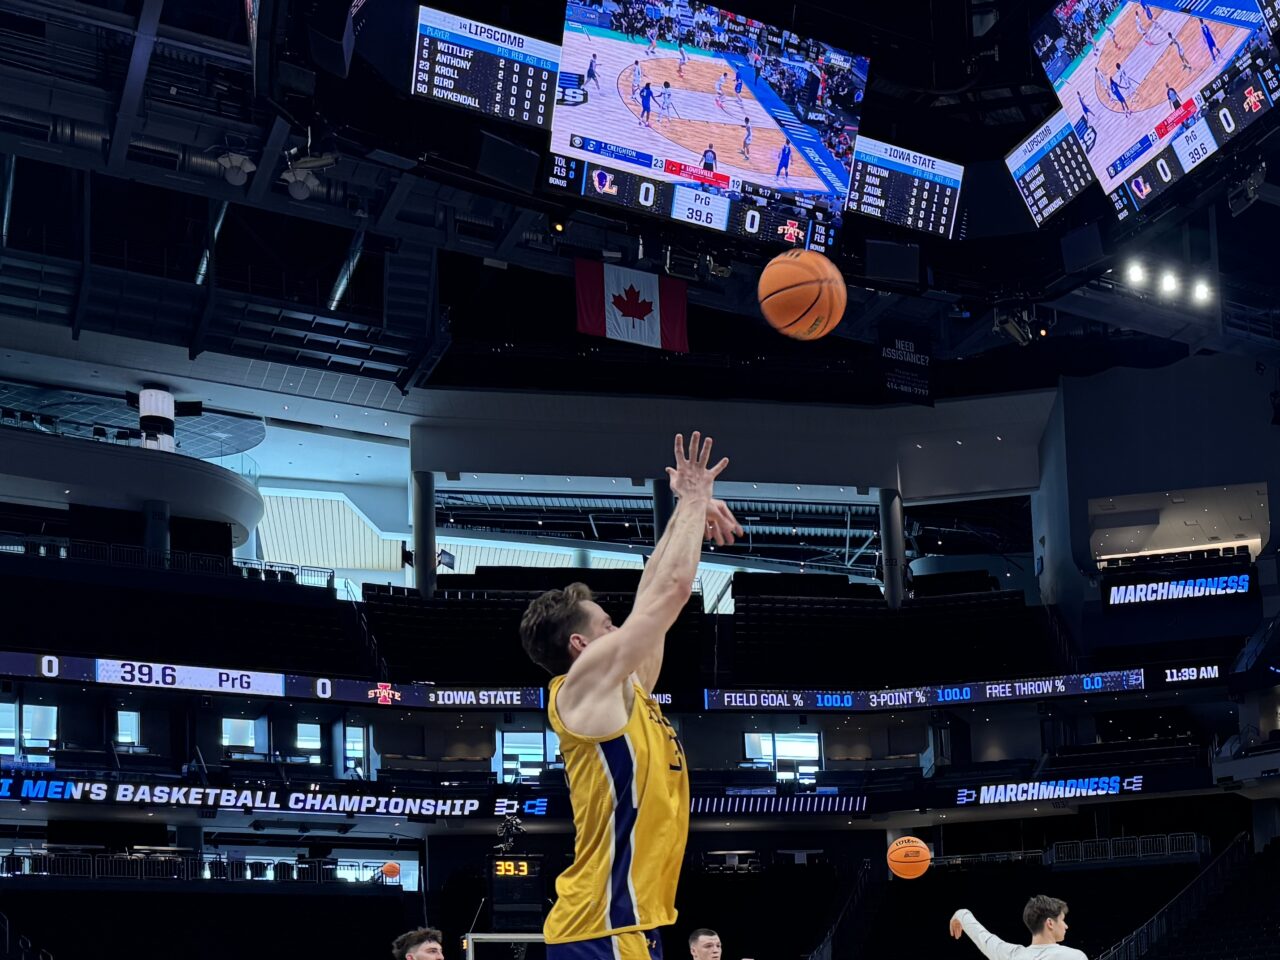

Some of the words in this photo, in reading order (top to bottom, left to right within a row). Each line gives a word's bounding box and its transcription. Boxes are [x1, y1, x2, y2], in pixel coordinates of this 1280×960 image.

[1210, 5, 1232, 19] FIRST
[1232, 8, 1261, 23] ROUND
[1264, 7, 1273, 19] 23
[1269, 18, 1278, 29] 45
[468, 23, 524, 48] LIPSCOMB
[426, 26, 450, 40] PLAYER
[497, 47, 509, 57] PTS
[511, 51, 524, 61] REB
[525, 55, 537, 65] AST
[540, 58, 551, 69] FLS
[436, 41, 473, 59] WITTLIFF
[419, 60, 430, 71] 23
[435, 64, 459, 79] KROLL
[436, 53, 471, 70] ANTHONY
[417, 72, 429, 82] 24
[434, 76, 454, 89] BIRD
[416, 83, 428, 94] 50
[432, 87, 480, 108] KUYKENDALL
[1219, 107, 1235, 134] 0
[1025, 125, 1052, 153] LIPSCOMB
[1184, 130, 1198, 146] PrG
[554, 156, 567, 168] TOL
[889, 147, 911, 163] IOWA
[912, 154, 936, 170] STATE
[1188, 143, 1208, 164] 39.6
[553, 166, 566, 177] FLS
[653, 158, 664, 169] 23
[867, 165, 889, 178] FULTON
[1156, 158, 1172, 183] 0
[549, 177, 567, 187] BONUS
[731, 180, 741, 189] 19
[758, 187, 772, 197] 9:17
[865, 174, 880, 186] MAN
[638, 182, 656, 207] 0
[863, 184, 882, 196] ZAIDE
[694, 194, 711, 207] PrG
[850, 191, 859, 200] 23
[862, 194, 885, 207] JORDAN
[686, 207, 714, 225] 39.6
[848, 201, 858, 210] 45
[860, 204, 882, 217] VIRGIL
[745, 209, 761, 234] 0
[815, 224, 826, 235] TOL
[777, 225, 805, 241] STATE
[814, 232, 825, 244] FLS
[895, 338, 915, 353] NEED
[1110, 574, 1250, 605] MARCHMADNESS
[41, 655, 59, 678] 0
[120, 662, 177, 687] 39.6
[218, 671, 252, 690] PrG
[316, 678, 332, 700] 0
[1165, 667, 1198, 683] 11:39
[1199, 665, 1220, 680] AM
[368, 690, 401, 702] STATE
[437, 691, 477, 705] IOWA
[479, 691, 521, 706] STATE
[724, 693, 758, 707] FIELD
[760, 693, 791, 707] GOAL
[792, 693, 804, 707] %
[816, 694, 853, 707] 100.0
[869, 691, 914, 707] 3-POINT
[915, 690, 926, 703] %
[937, 687, 971, 702] 100.0
[986, 684, 1013, 699] FREE
[1014, 680, 1053, 696] THROW
[1054, 680, 1066, 693] %
[1083, 676, 1102, 690] 0.0
[21, 780, 108, 801] MEN'S
[116, 784, 281, 809] BASKETBALL
[288, 793, 479, 816] CHAMPIONSHIP
[980, 776, 1121, 804] MARCHMADNESS
[496, 861, 528, 876] 39.3
